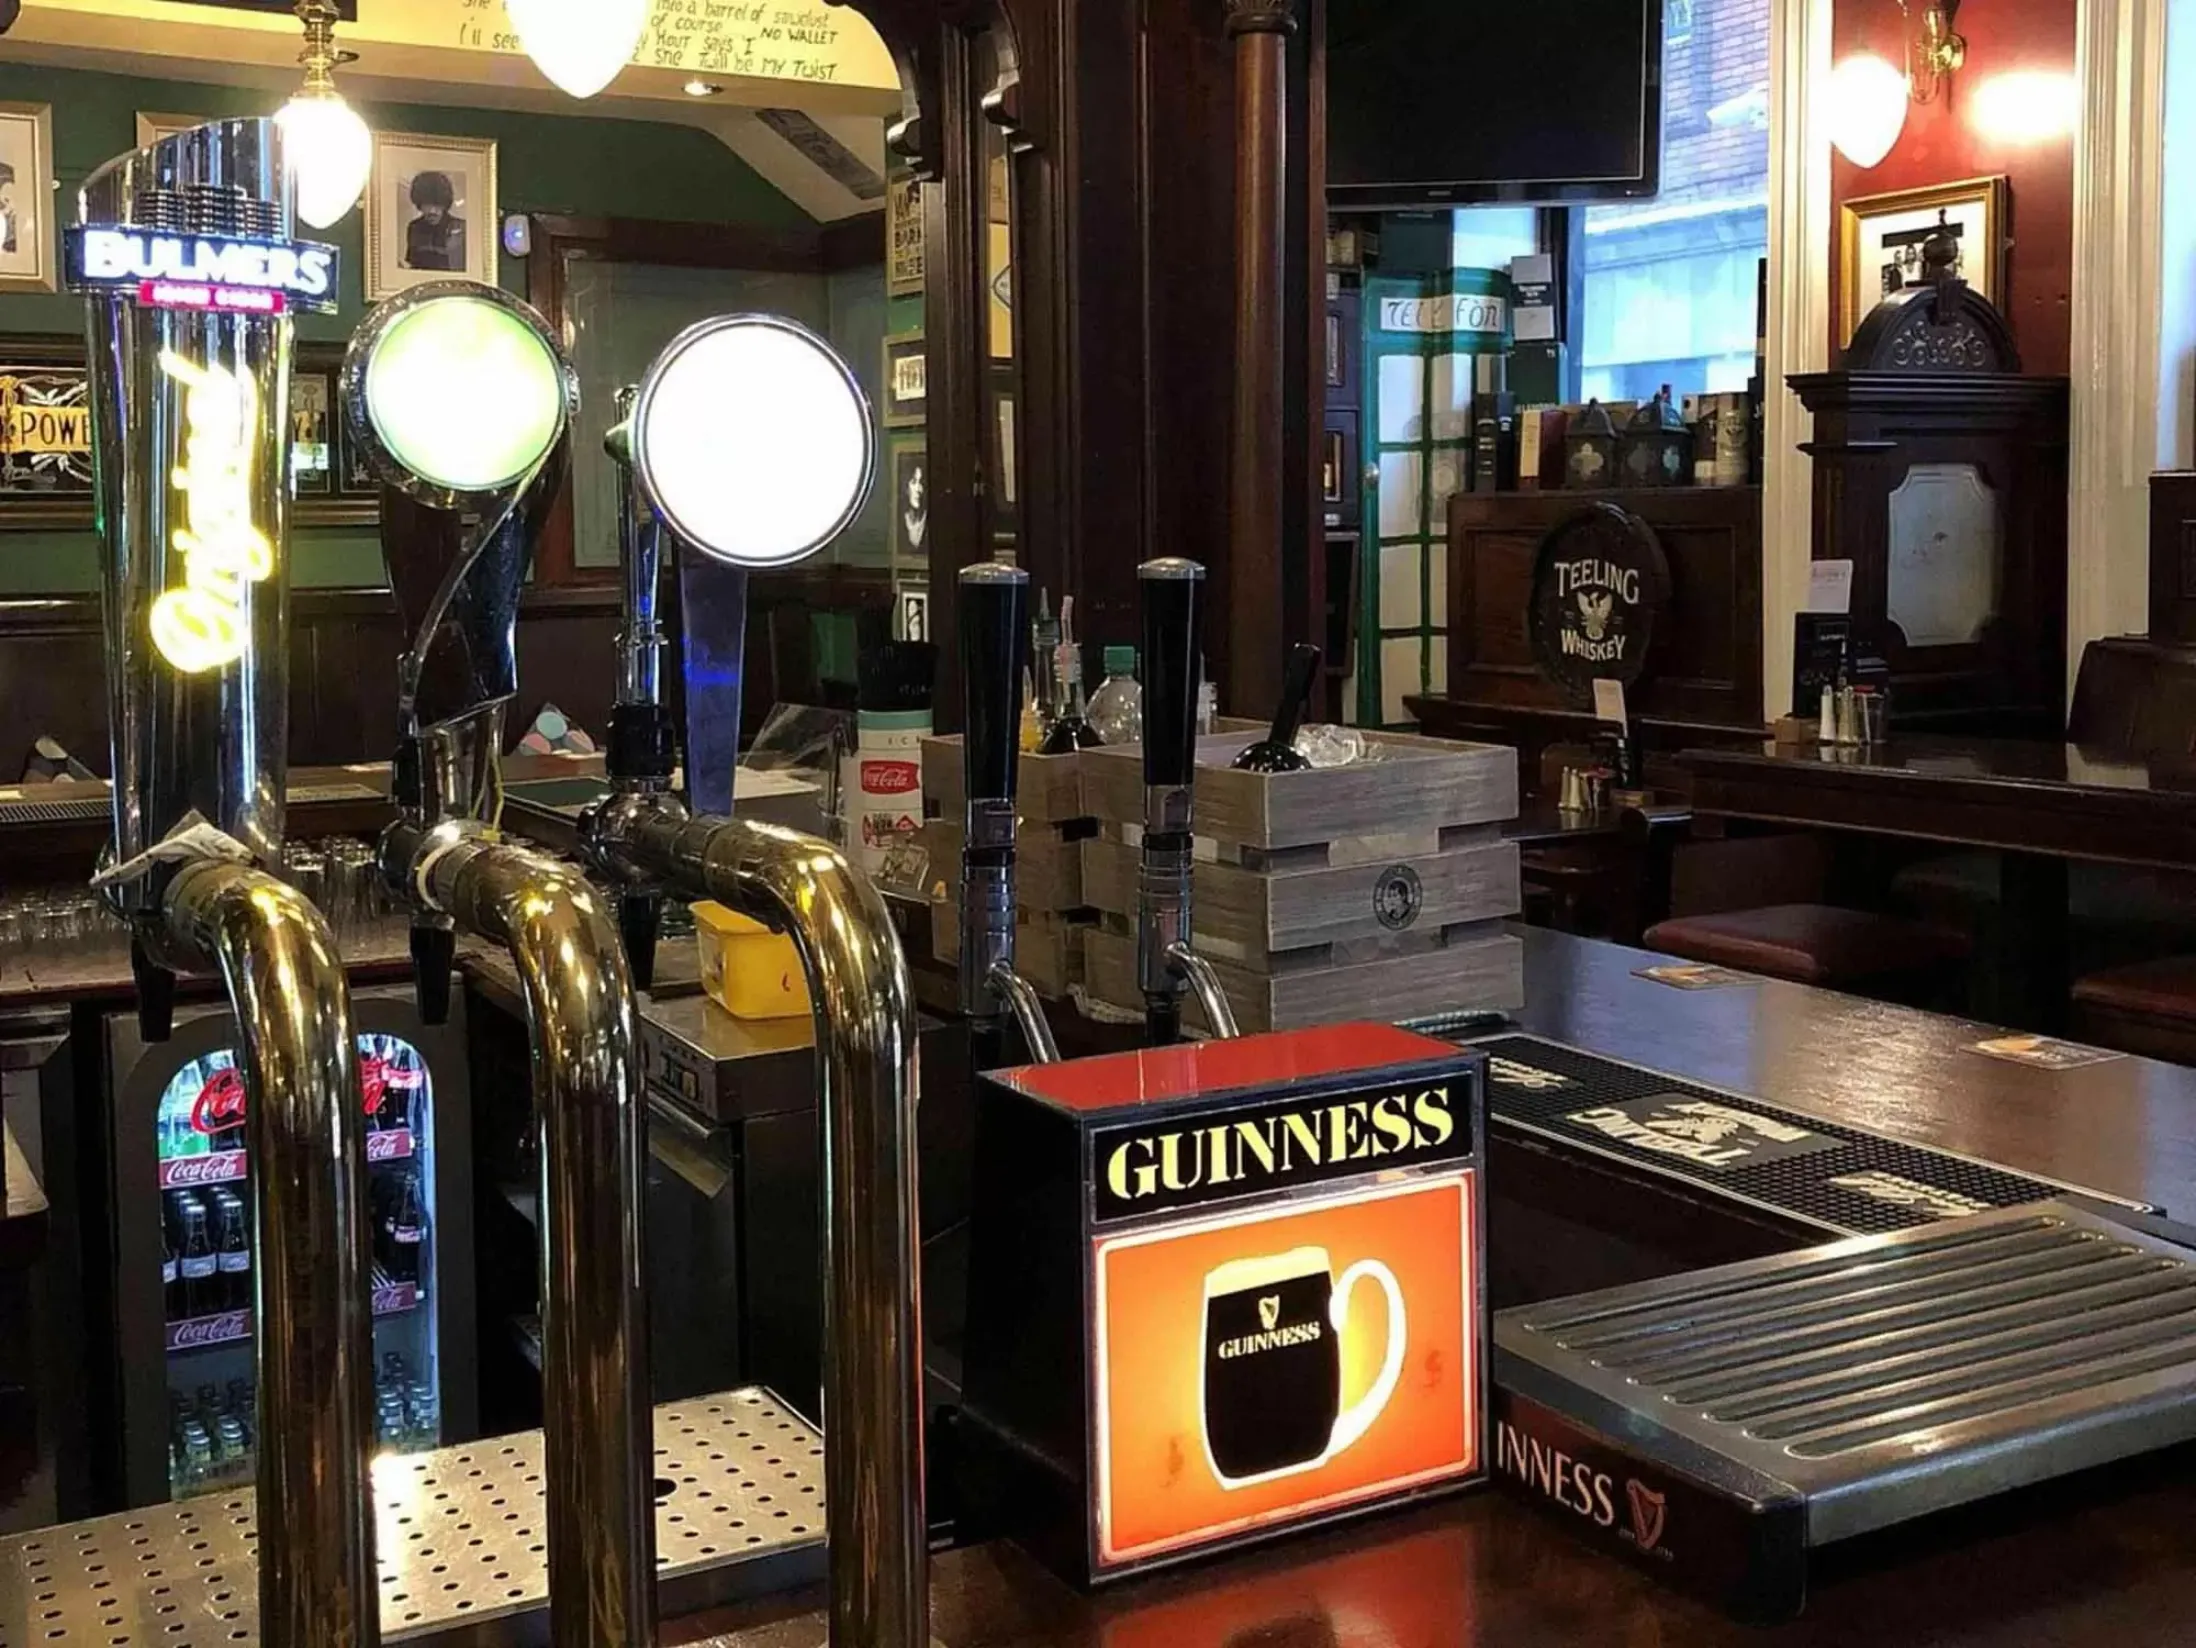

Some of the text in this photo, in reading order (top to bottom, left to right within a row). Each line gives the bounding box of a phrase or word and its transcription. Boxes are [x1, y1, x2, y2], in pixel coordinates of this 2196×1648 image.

[492, 32, 520, 49] see
[651, 13, 668, 28] of
[675, 16, 723, 33] course
[760, 28, 782, 41] NO
[788, 28, 838, 45] WALLET
[84, 230, 330, 295] BULMERS
[1554, 559, 1640, 604] TEELING
[1560, 629, 1626, 661] WHISKEY
[1107, 1088, 1453, 1200] GUINNESS
[1218, 1320, 1321, 1360] GUINNESS
[1498, 1420, 1614, 1526] INNESS
